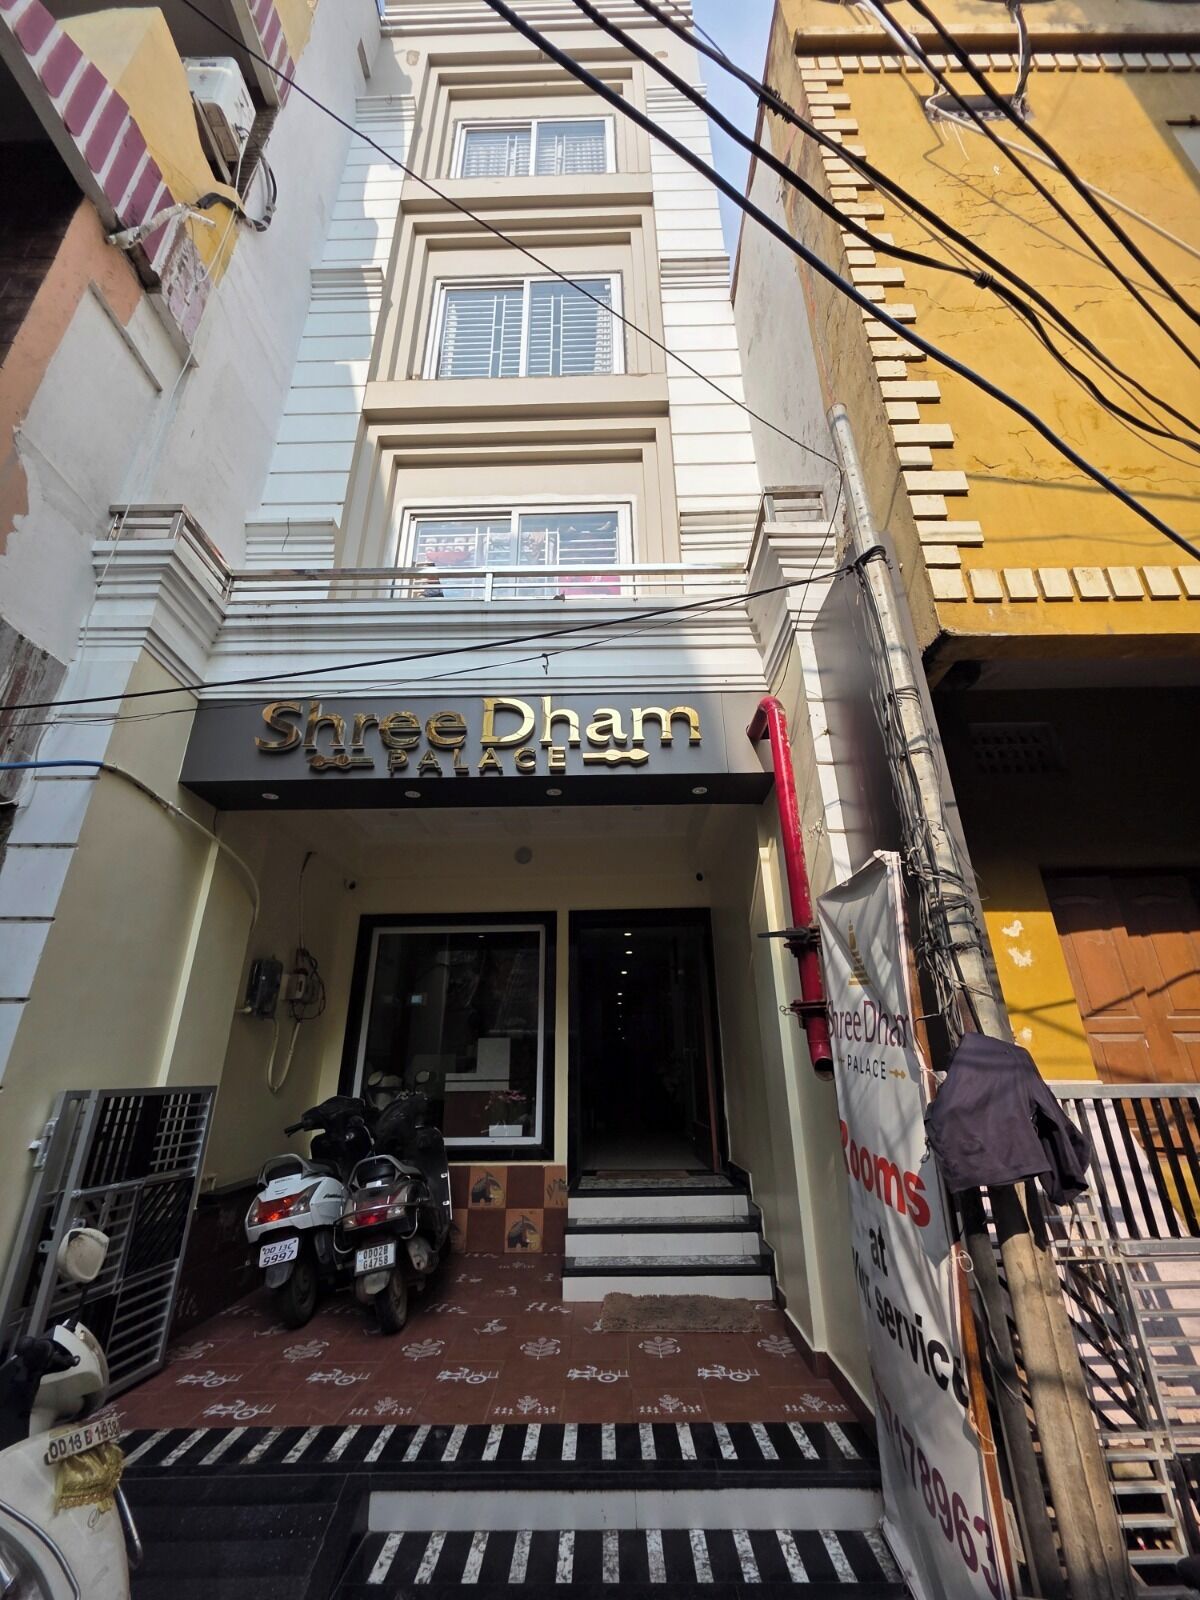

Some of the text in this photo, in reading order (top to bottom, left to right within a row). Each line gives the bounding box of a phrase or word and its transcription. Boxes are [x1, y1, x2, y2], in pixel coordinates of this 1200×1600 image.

[387, 746, 566, 778] PALACE
[847, 1054, 887, 1080] PALACE
[263, 1250, 295, 1266] 9997
[869, 1225, 888, 1277] at
